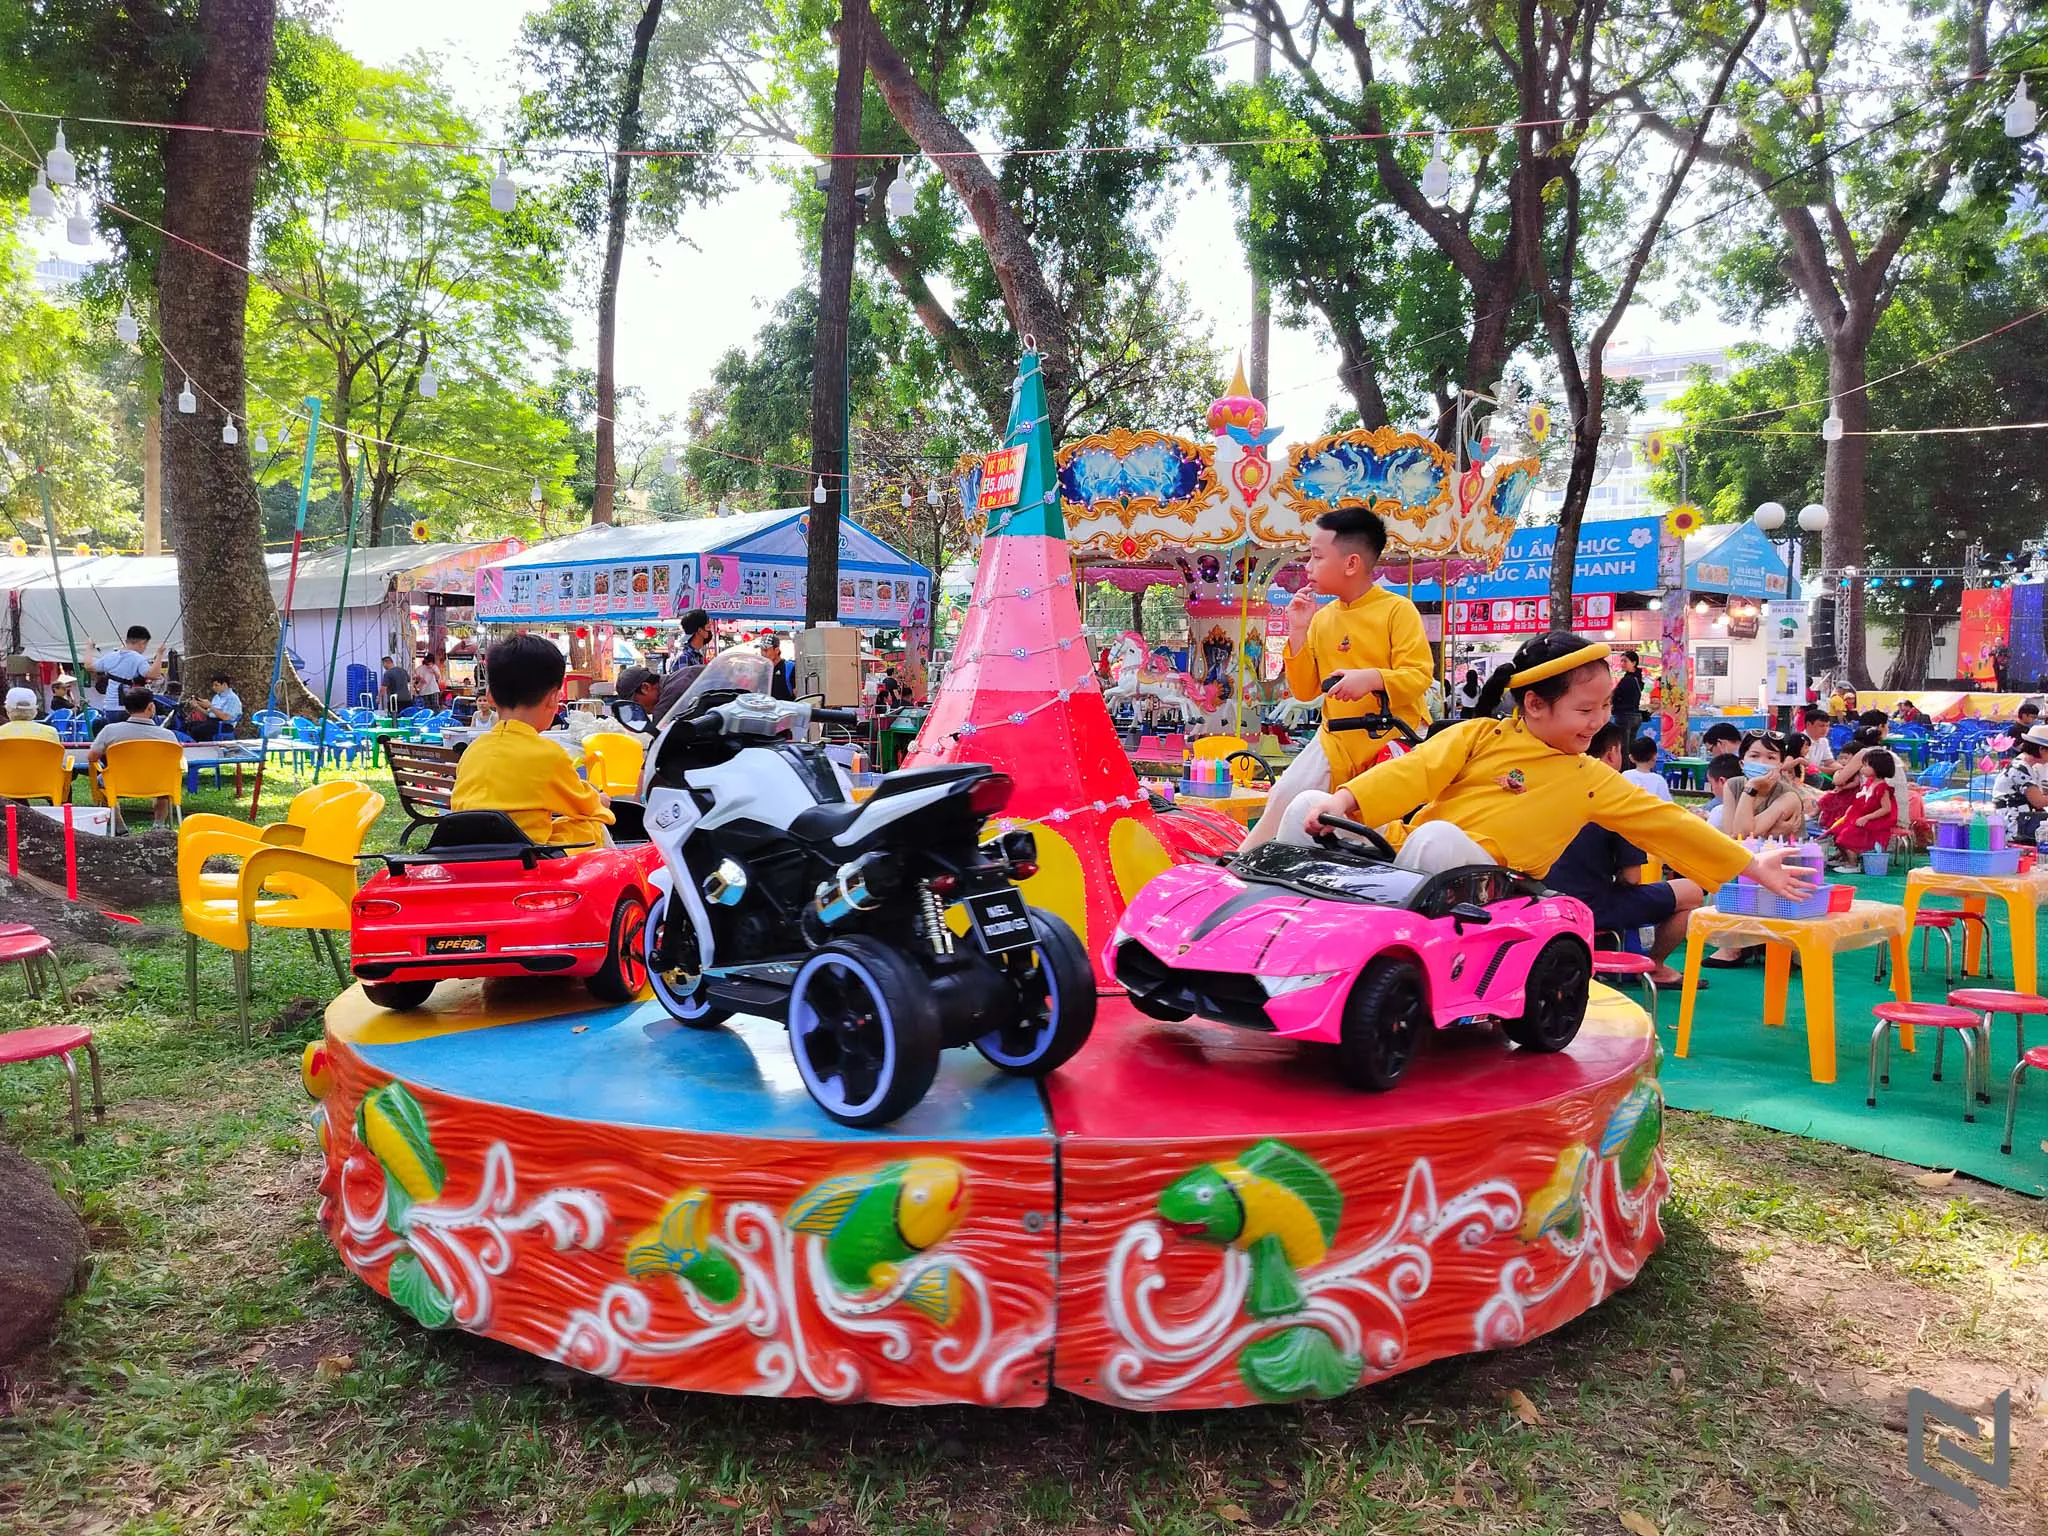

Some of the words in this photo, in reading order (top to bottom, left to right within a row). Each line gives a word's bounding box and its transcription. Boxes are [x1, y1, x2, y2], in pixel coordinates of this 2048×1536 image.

[1577, 537, 1620, 556] HỰC
[1525, 563, 1552, 580] ĂN
[1575, 560, 1635, 577] HANH
